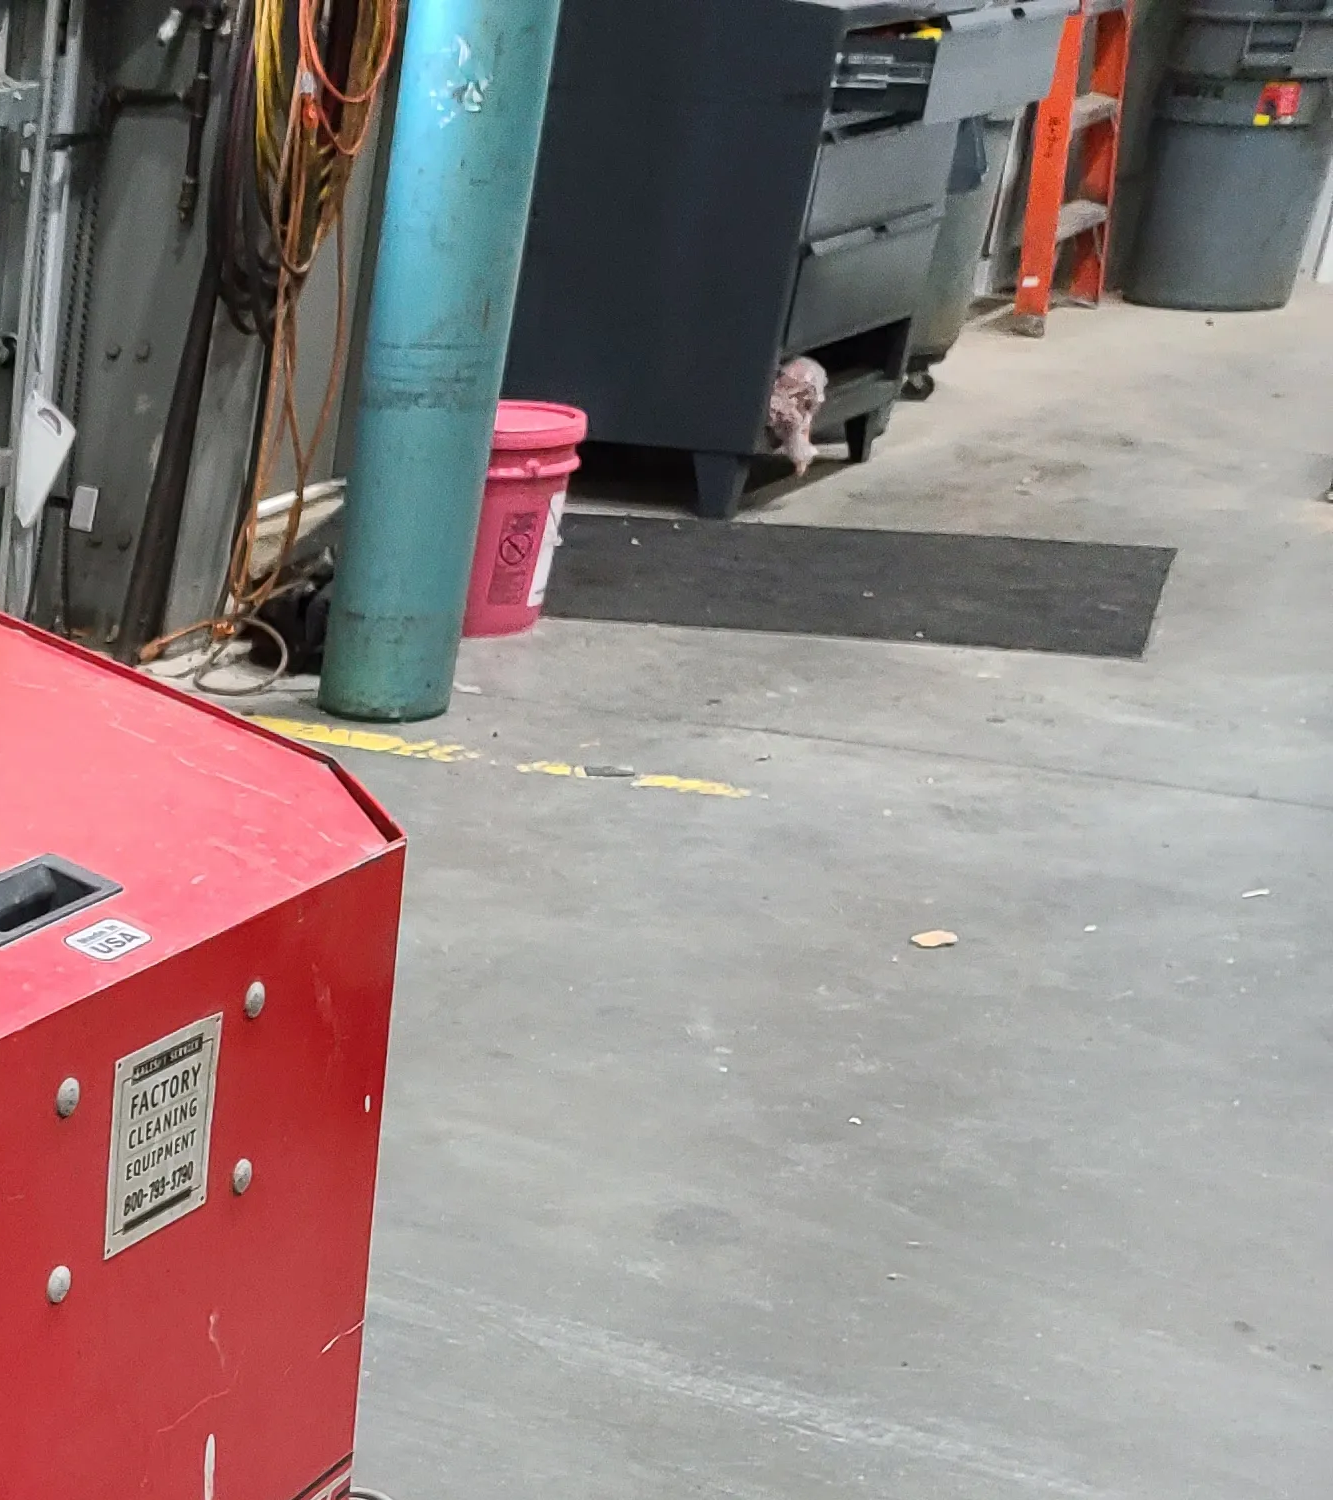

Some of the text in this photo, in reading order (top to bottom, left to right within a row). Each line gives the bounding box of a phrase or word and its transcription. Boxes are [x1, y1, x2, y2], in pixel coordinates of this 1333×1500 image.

[91, 932, 140, 954] USA
[131, 1063, 201, 1119] FACTORY
[128, 1097, 197, 1149] CLEANING
[125, 1129, 196, 1180] EQUIPMENT
